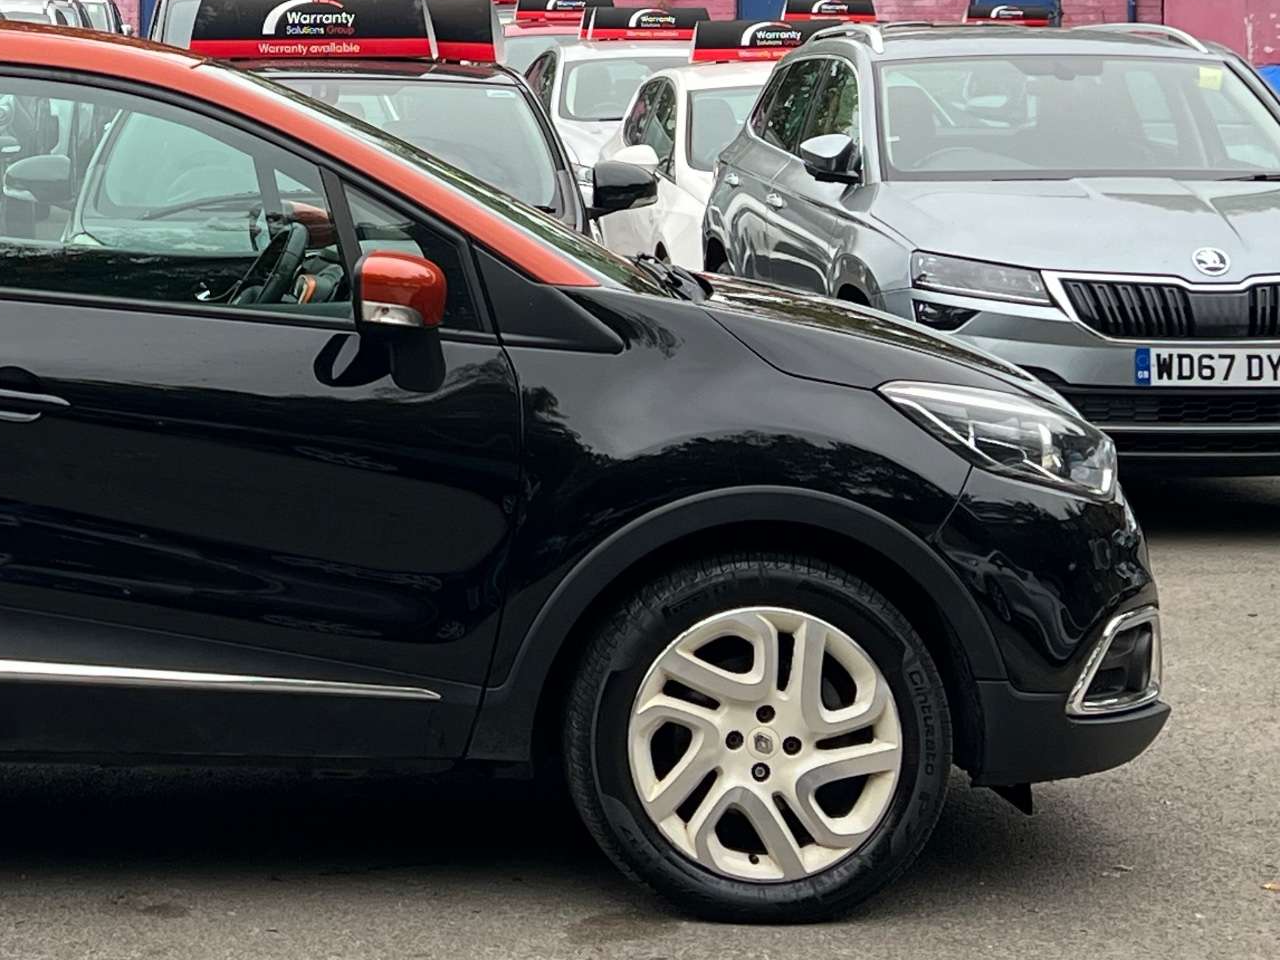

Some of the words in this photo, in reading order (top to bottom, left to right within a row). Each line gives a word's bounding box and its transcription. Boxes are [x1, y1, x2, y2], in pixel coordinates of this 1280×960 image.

[286, 11, 356, 27] Warranty
[326, 25, 355, 36] Group
[756, 30, 802, 41] Warranty
[258, 43, 308, 56] Warranty
[309, 41, 361, 54] available
[1156, 353, 1236, 381] WD67
[1246, 354, 1280, 382] DY
[1138, 371, 1149, 379] GB
